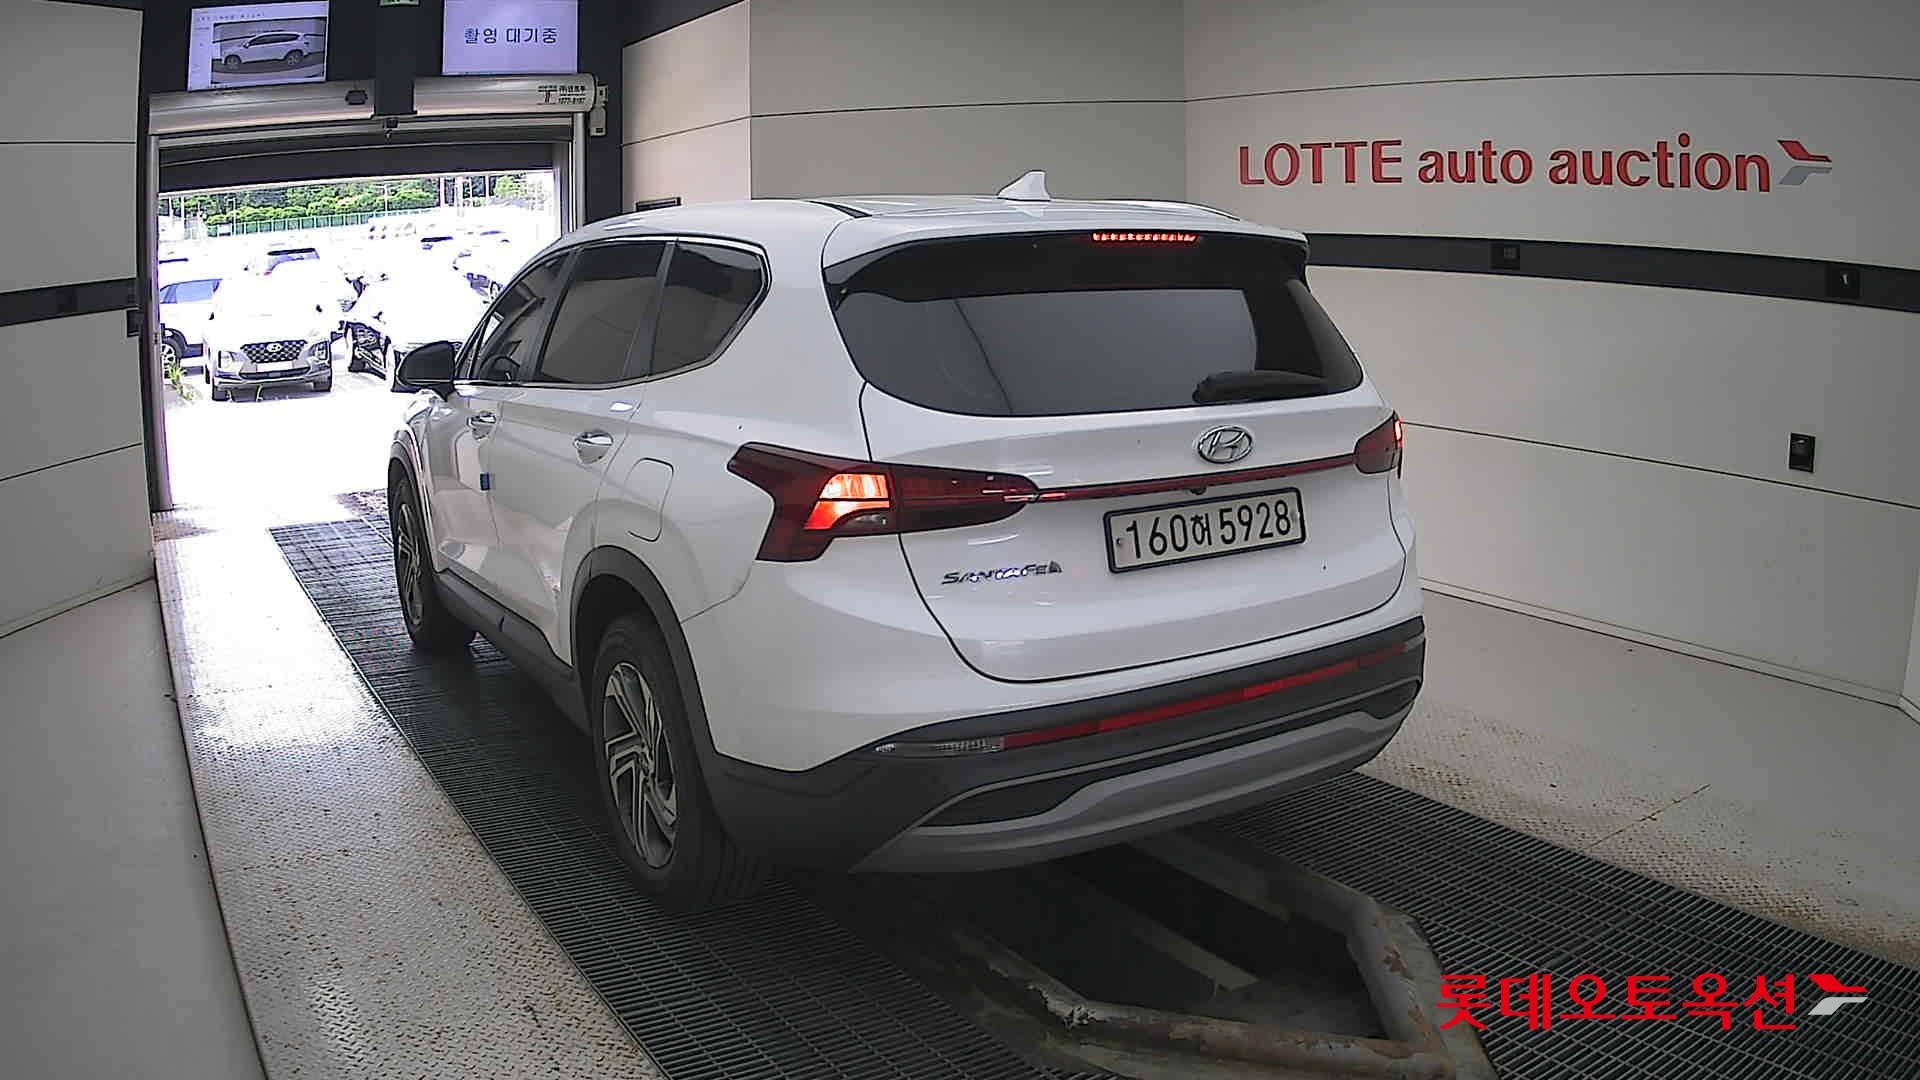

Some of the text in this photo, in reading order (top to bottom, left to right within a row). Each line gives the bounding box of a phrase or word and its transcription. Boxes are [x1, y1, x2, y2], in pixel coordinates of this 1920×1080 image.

[506, 27, 558, 44] 대기중
[1239, 132, 1770, 192] LOTTE auto auction
